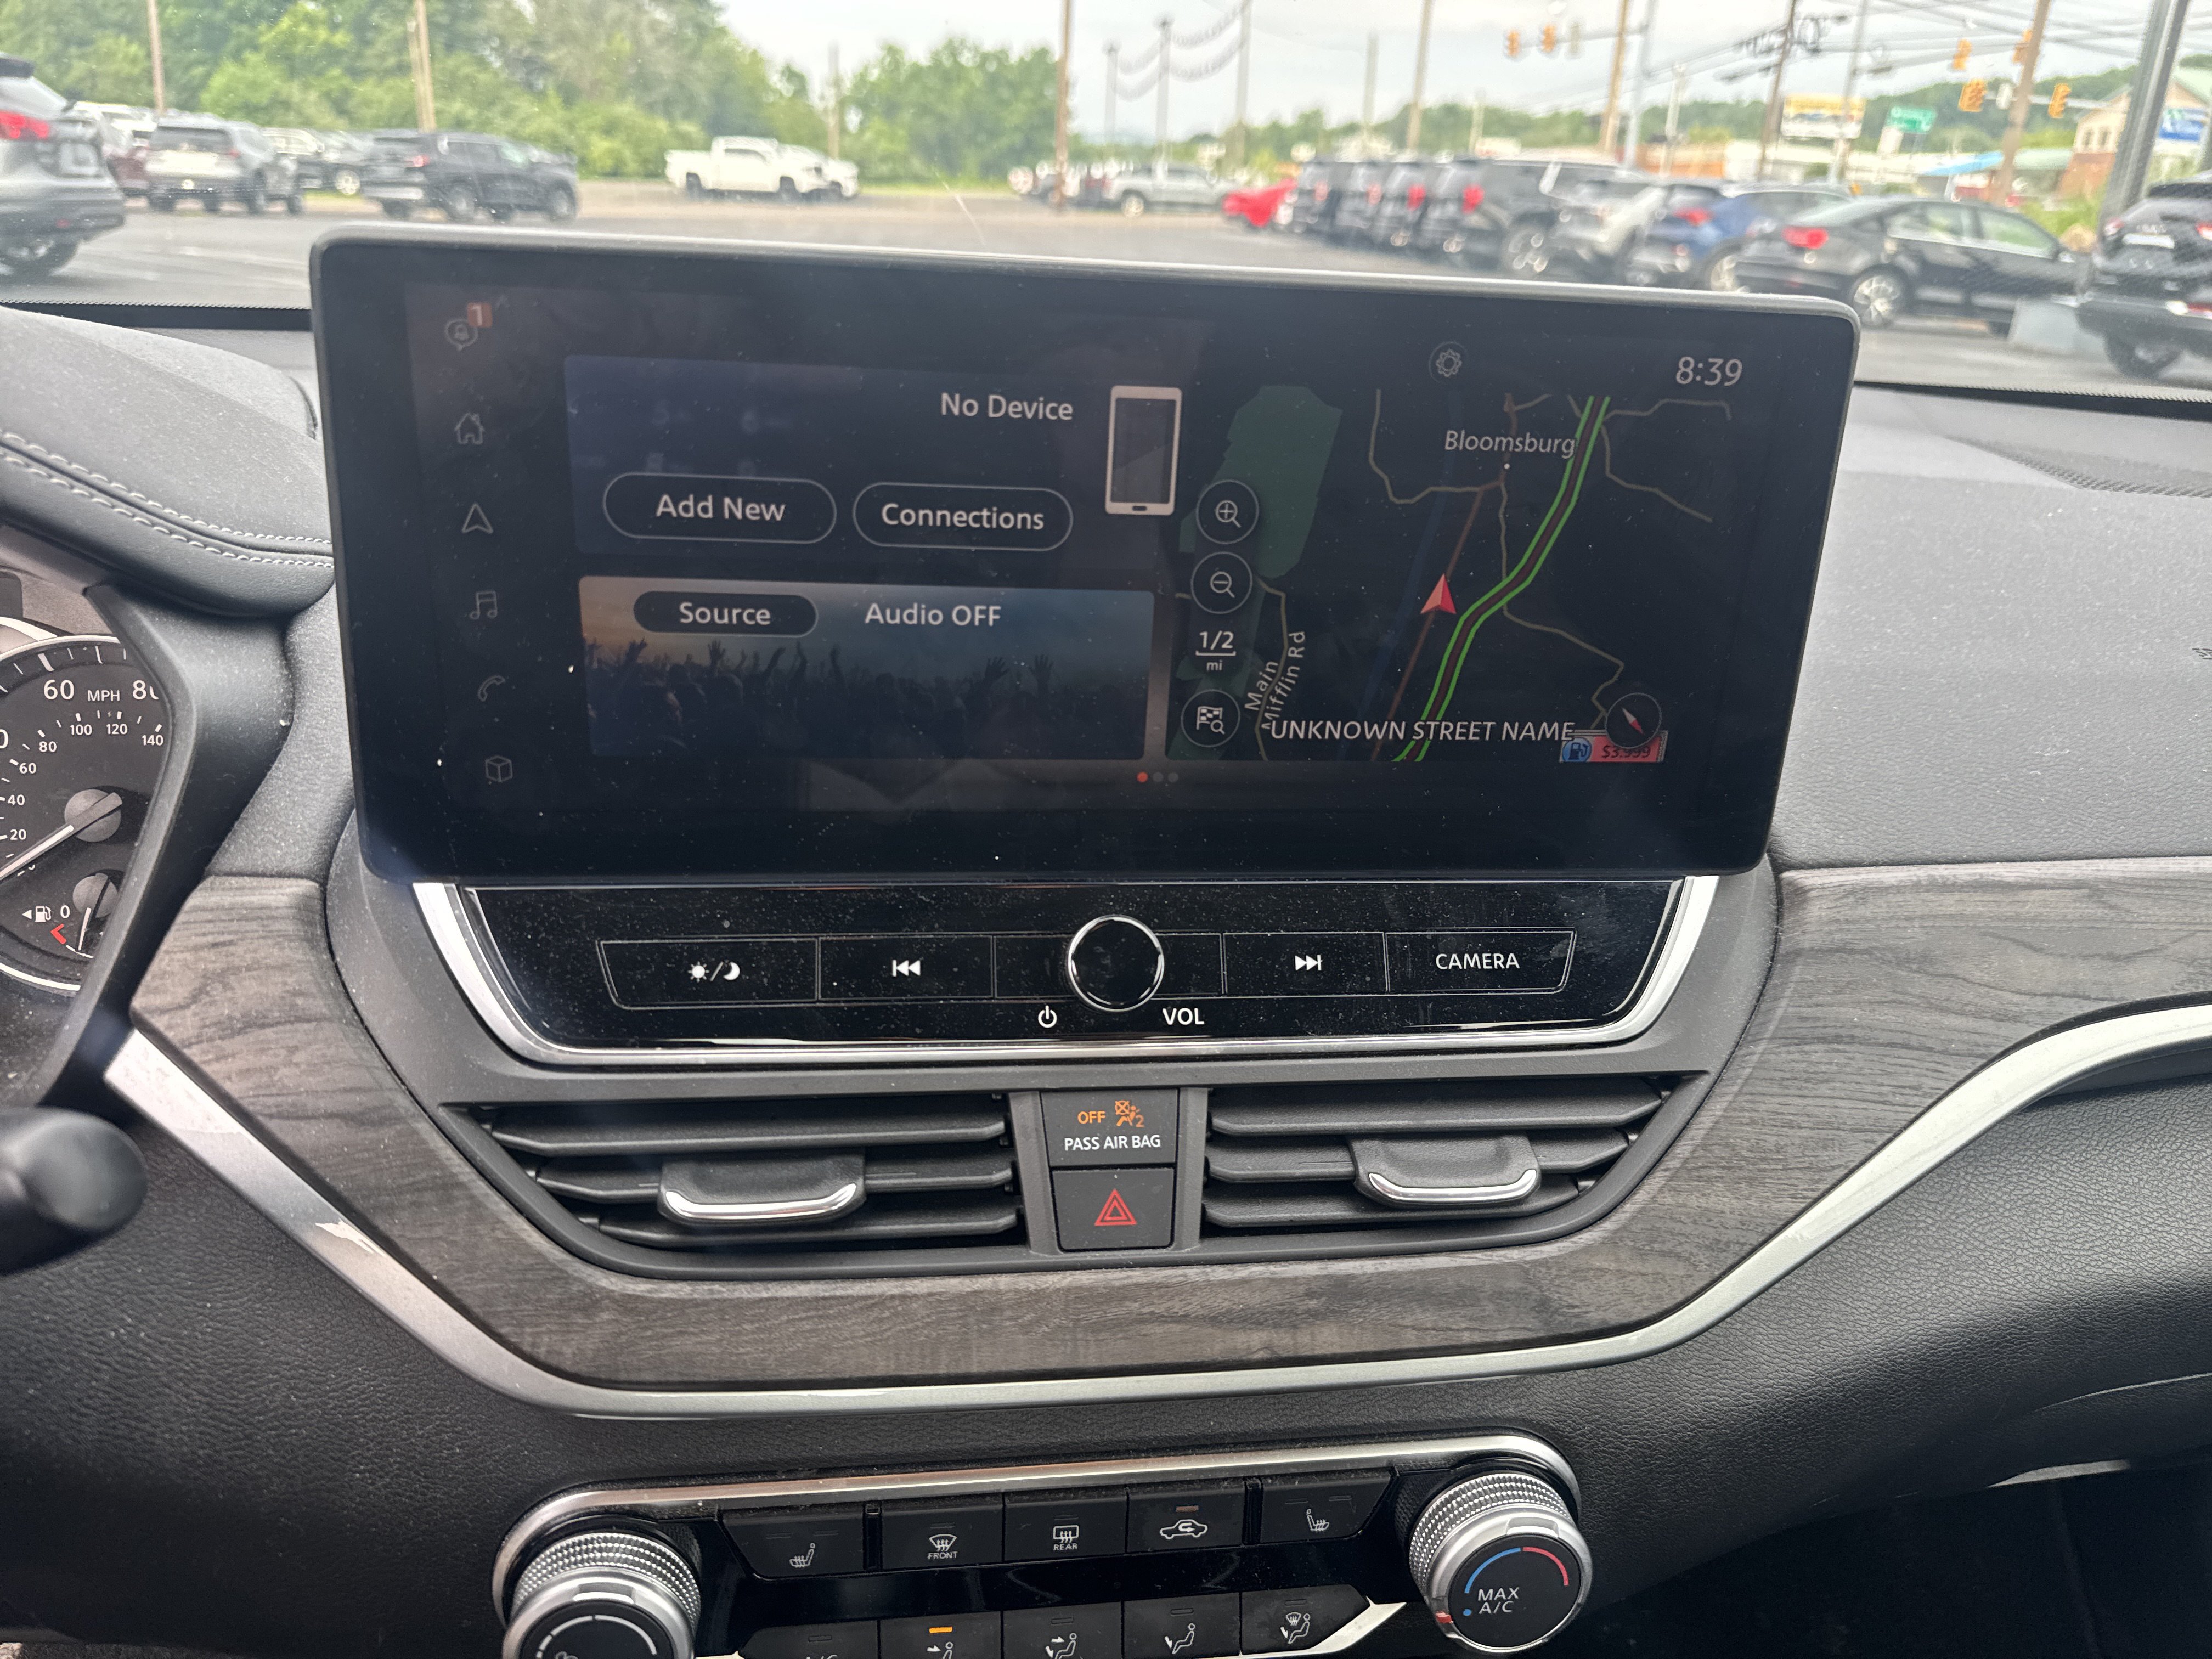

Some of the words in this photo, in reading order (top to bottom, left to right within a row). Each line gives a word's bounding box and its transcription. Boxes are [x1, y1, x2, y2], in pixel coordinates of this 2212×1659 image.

[1675, 356, 1742, 386] 8:39
[941, 392, 978, 416] No
[988, 394, 1073, 420] Device
[1444, 430, 1576, 459] Bloomsburg
[657, 494, 713, 518] Add
[724, 497, 785, 521] New
[882, 503, 1043, 530] Connections
[680, 602, 770, 625] Source
[865, 603, 943, 625] Audio
[952, 606, 1001, 627] OFF
[1200, 630, 1234, 650] 1/2
[1288, 631, 1305, 658] Rd
[1206, 660, 1223, 671] mi
[43, 679, 75, 700] 60
[1244, 661, 1279, 710] Main
[87, 690, 120, 702] MPH
[70, 724, 92, 736] 100
[106, 724, 128, 735] 120
[1271, 720, 1406, 739] UNKNOWN
[1413, 721, 1496, 740] STREET
[1502, 721, 1576, 741] NAME
[39, 741, 57, 753] 80
[142, 735, 164, 746] 140
[19, 762, 37, 774] 60
[7, 794, 25, 806] 40
[10, 829, 27, 840] 20
[60, 905, 70, 919] 0
[1436, 953, 1520, 970] CAMERA
[1162, 1007, 1205, 1025] VOL
[1077, 1110, 1106, 1124] OFF
[1064, 1136, 1100, 1151] PASS
[1103, 1136, 1128, 1149] AIR
[1132, 1135, 1161, 1148] BAG
[928, 1551, 958, 1560] FRONT
[1477, 1587, 1520, 1601] MAX
[1478, 1600, 1514, 1615] A/C
